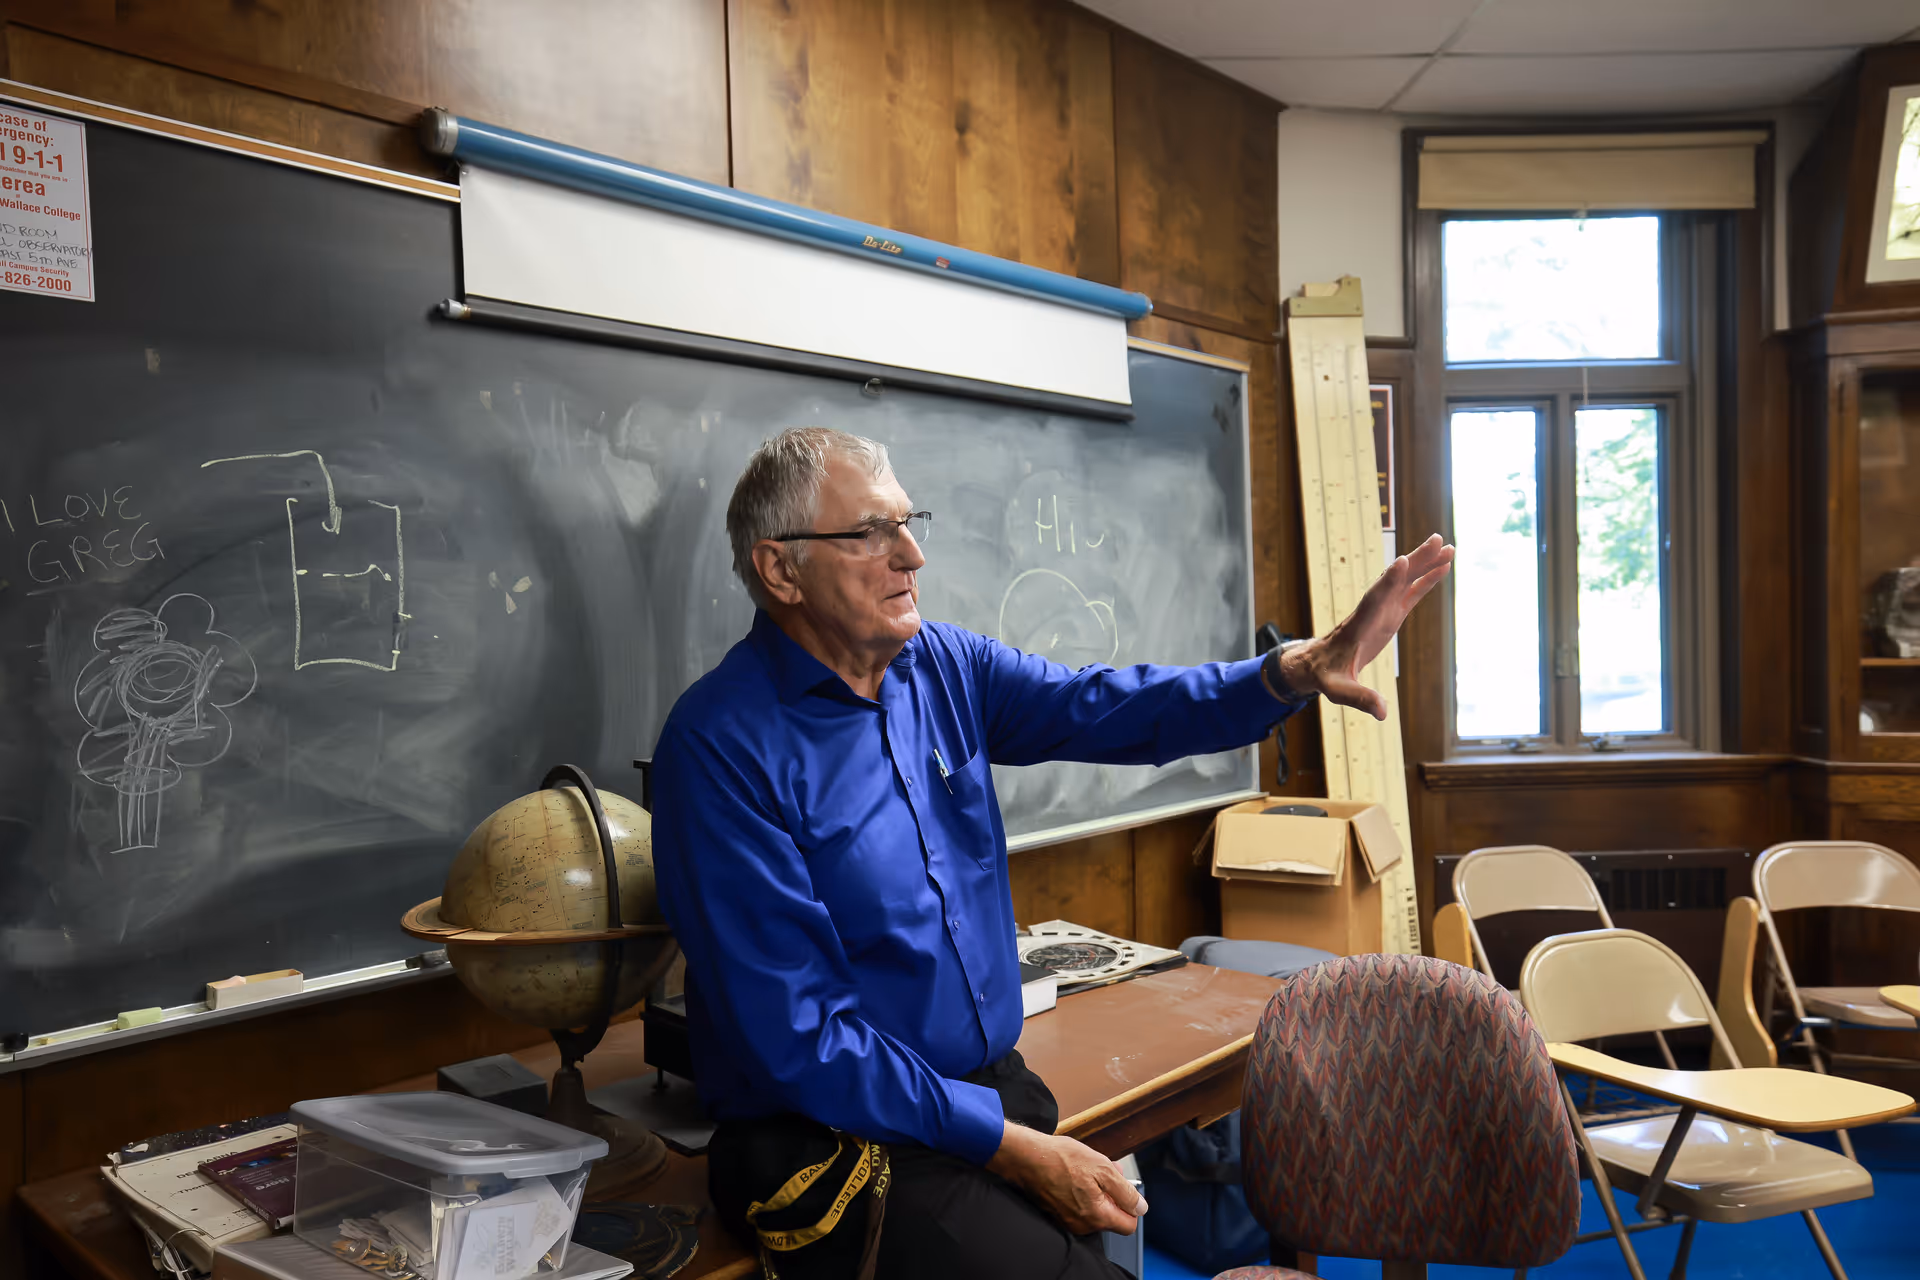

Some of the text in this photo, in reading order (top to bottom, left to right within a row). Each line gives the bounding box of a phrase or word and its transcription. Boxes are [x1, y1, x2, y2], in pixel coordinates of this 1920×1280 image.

[34, 120, 47, 132] of
[13, 144, 63, 172] 9-1-1
[0, 176, 46, 196] erea
[0, 198, 81, 221] Wallace College
[19, 226, 58, 239] ROOM
[9, 262, 38, 272] Campus
[40, 266, 69, 278] Security
[57, 257, 78, 268] AVE
[30, 486, 141, 526] LOVE
[28, 522, 166, 583] GREG
[830, 1158, 870, 1220] COLLEGE
